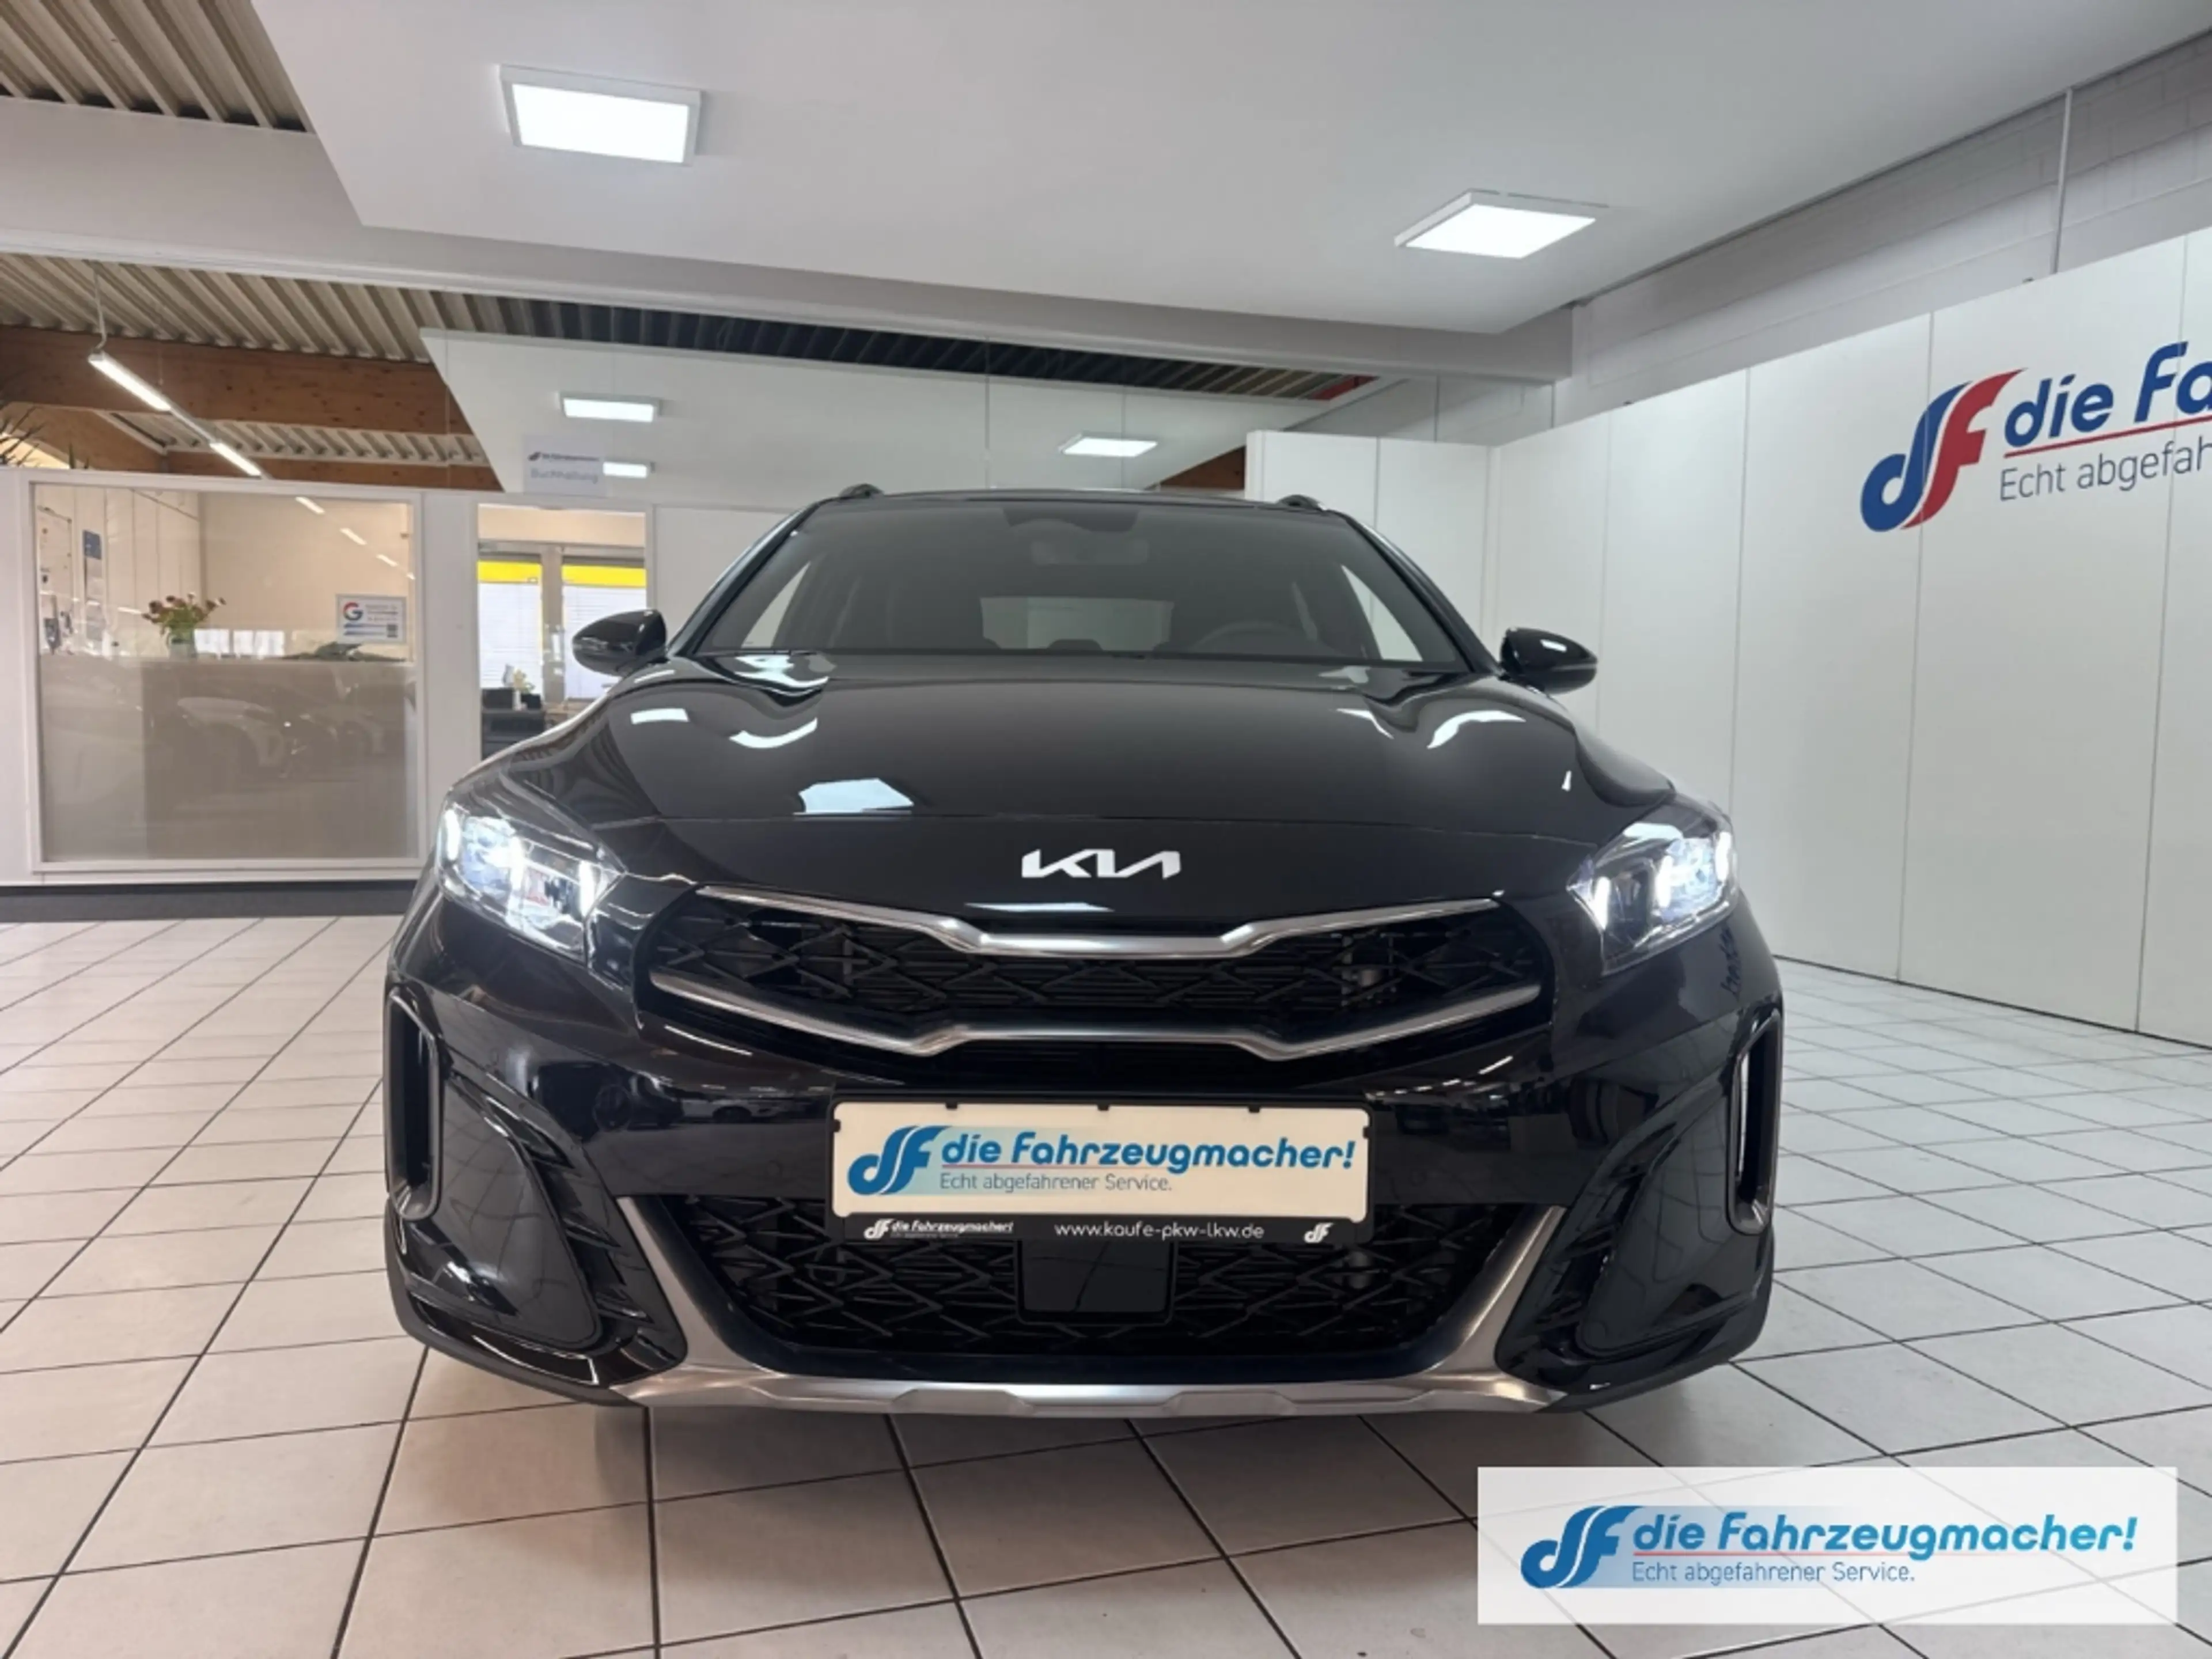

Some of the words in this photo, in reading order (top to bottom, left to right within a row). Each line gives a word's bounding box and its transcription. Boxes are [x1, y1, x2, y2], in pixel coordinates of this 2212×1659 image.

[2004, 373, 2114, 447] die
[1999, 463, 2066, 501] Echt
[1021, 849, 1181, 880] KIA
[941, 1134, 1002, 1164] die
[1011, 1131, 1355, 1175] Fahrzeugmacher!
[940, 1173, 978, 1190] Echt
[983, 1173, 1099, 1193] abgefahrener
[1105, 1173, 1172, 1191] Service.
[1054, 1221, 1264, 1241] www.kaufe-pkw-lkw.de
